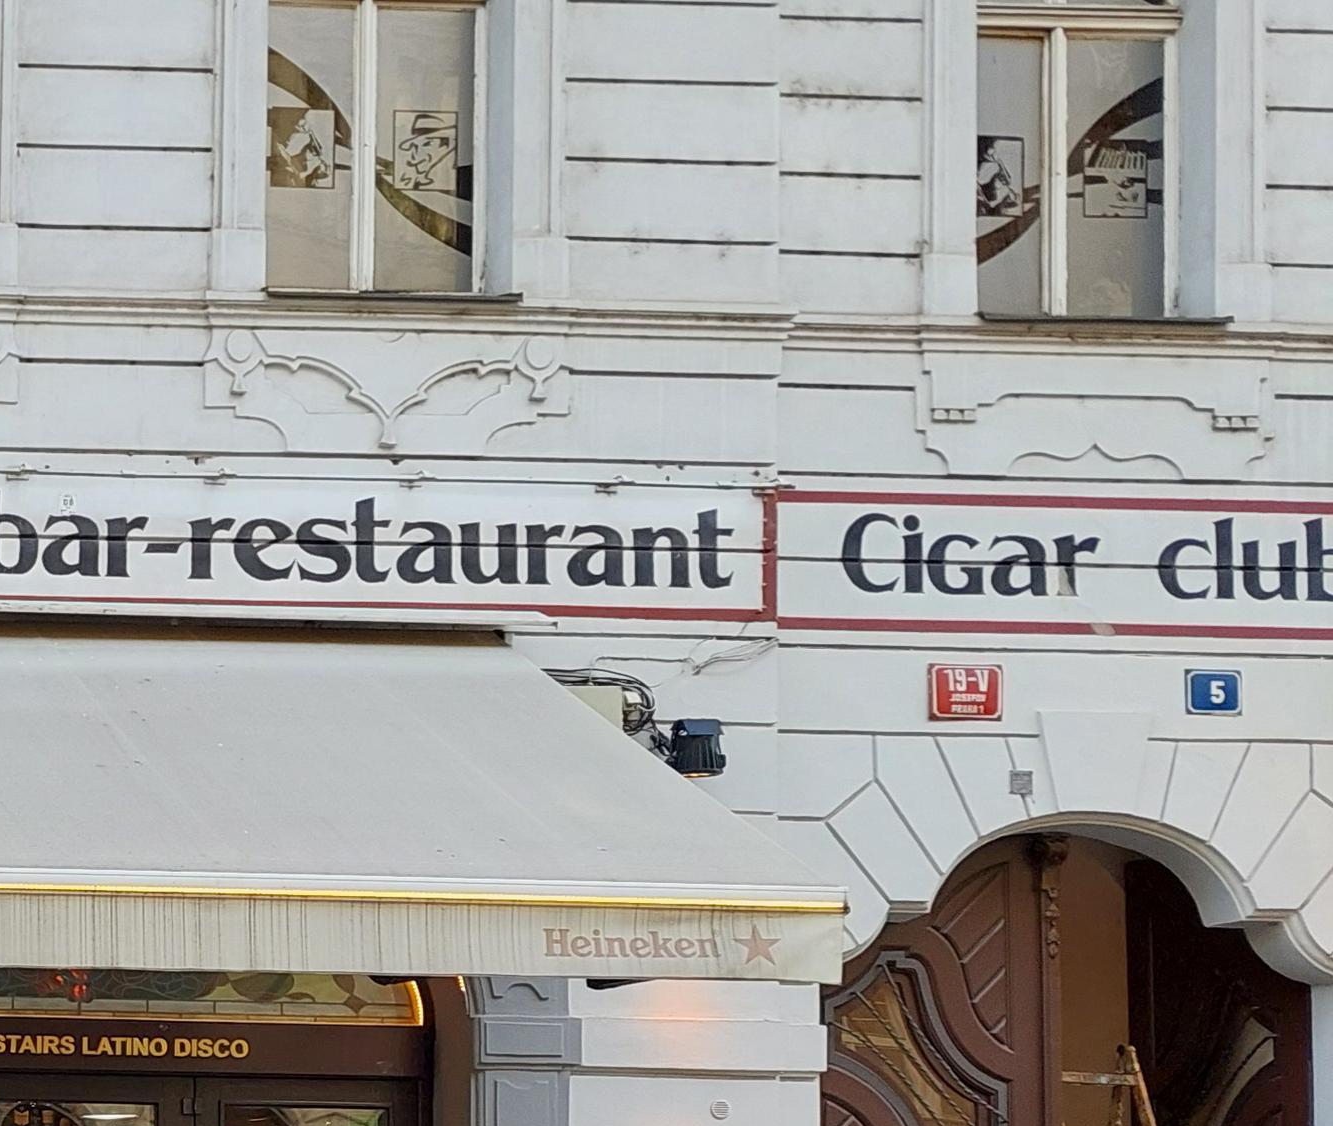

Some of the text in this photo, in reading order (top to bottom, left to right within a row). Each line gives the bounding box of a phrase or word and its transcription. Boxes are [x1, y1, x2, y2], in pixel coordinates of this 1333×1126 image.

[842, 513, 1100, 597] Cigar
[1209, 681, 1225, 704] 5
[543, 928, 721, 958] Heineken
[82, 1036, 168, 1056] LATINO
[174, 1038, 249, 1057] DISCO
